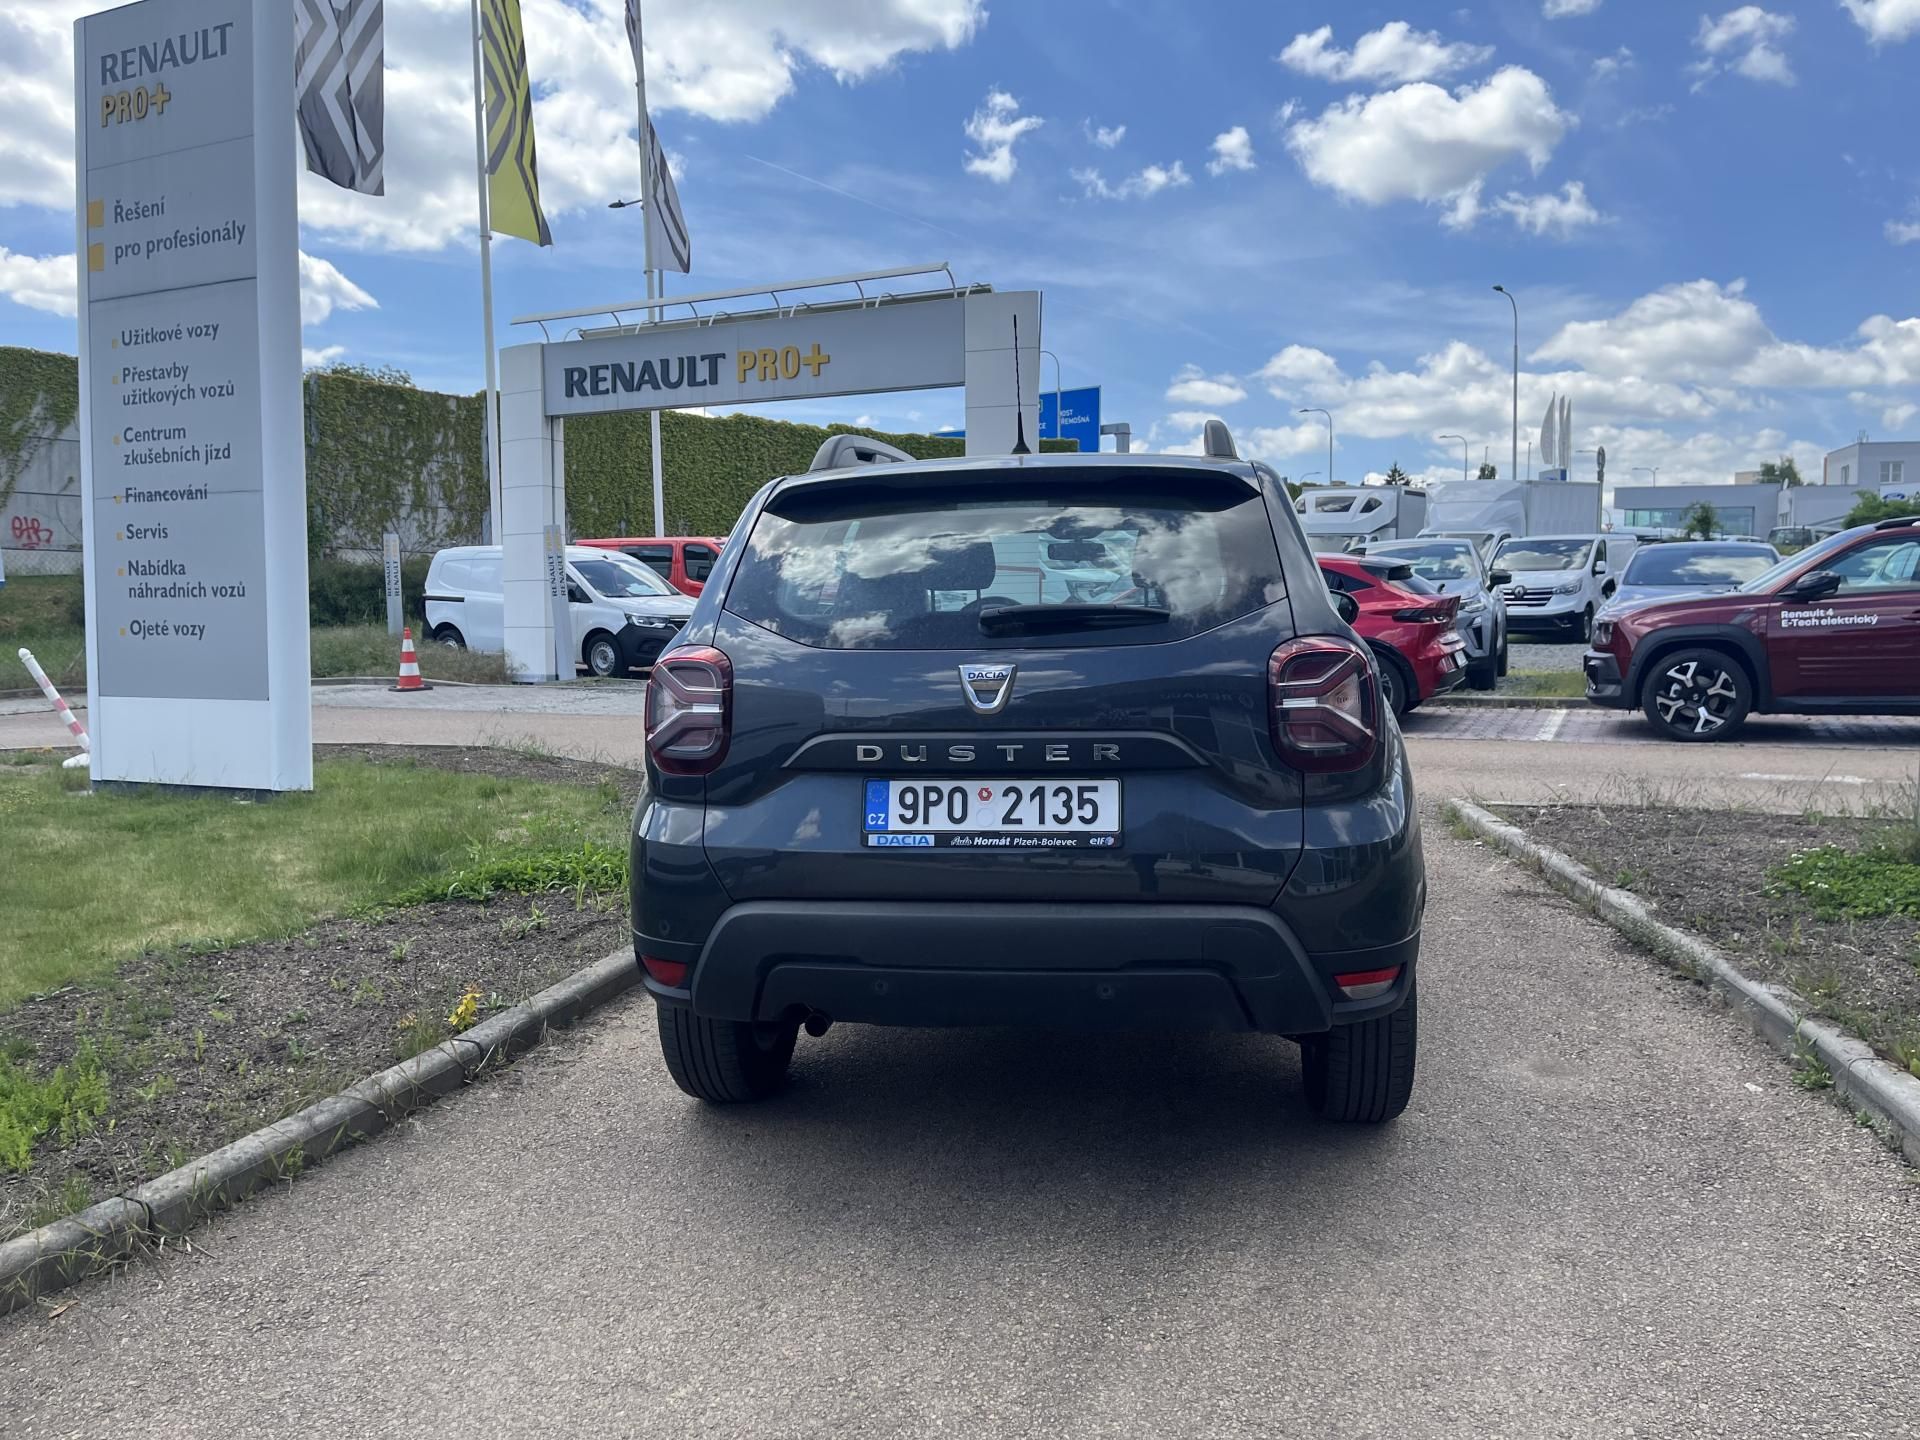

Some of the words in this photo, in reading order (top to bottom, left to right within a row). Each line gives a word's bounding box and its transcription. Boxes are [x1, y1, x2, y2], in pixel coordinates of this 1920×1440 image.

[100, 22, 234, 86] RENAULT
[101, 82, 171, 128] PRO+
[114, 196, 165, 224] Řešení
[114, 240, 141, 265] pro
[146, 220, 246, 255] profesionály
[121, 323, 183, 347] Užitkové
[187, 322, 220, 341] vozy
[122, 362, 189, 384] Přestavby
[564, 352, 726, 398] RENAULT
[737, 343, 830, 383] PRO+
[122, 385, 196, 406] užitkových
[200, 379, 234, 399] vozů
[123, 425, 187, 443] Centrum
[123, 446, 200, 466] zkušebních
[204, 442, 231, 465] jízd
[125, 483, 208, 503] Financování
[126, 524, 169, 540] Servis
[128, 560, 186, 577] Nabídka
[128, 582, 207, 599] náhradních
[211, 580, 246, 598] vozů
[1781, 609, 1825, 619] Renault
[1826, 608, 1834, 616] 4
[1781, 617, 1819, 627] E-Tech
[1821, 614, 1878, 625] elektrický
[129, 620, 169, 639] Ojeté
[173, 623, 206, 640] vozy
[967, 671, 1005, 680] DACIA
[856, 744, 1121, 762] DUSTER
[898, 785, 968, 825] 9P0
[1001, 785, 1099, 825] 2135
[867, 813, 886, 825] CZ
[876, 835, 930, 846] DACIA
[974, 836, 1011, 846] Hornát
[1014, 837, 1077, 846] Plzeň-Bolevec
[1089, 837, 1105, 845] elf
